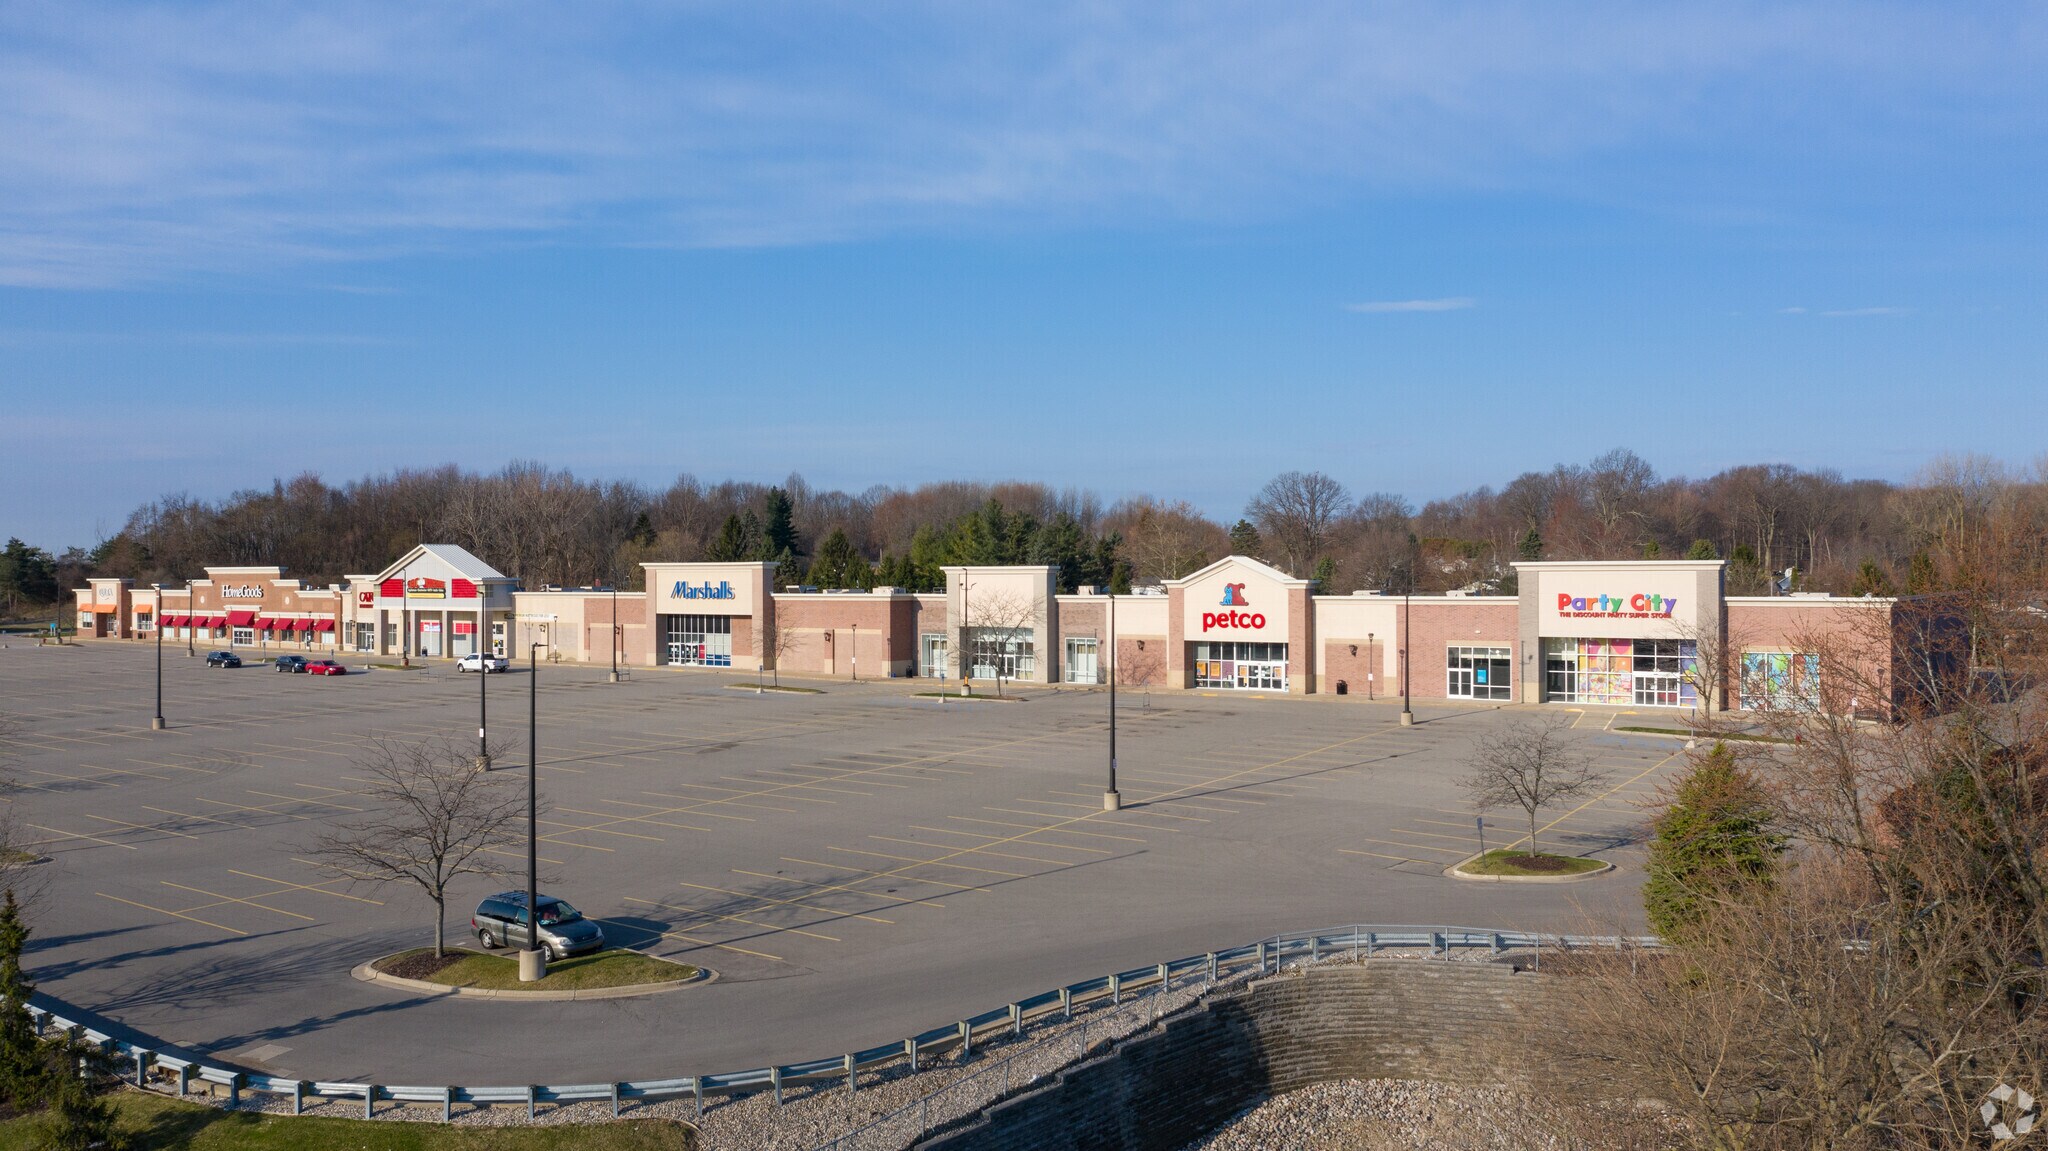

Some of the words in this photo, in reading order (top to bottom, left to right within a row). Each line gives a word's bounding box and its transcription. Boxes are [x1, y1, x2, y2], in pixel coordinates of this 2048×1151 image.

[222, 585, 264, 598] HomeGoods
[671, 581, 736, 600] Marshalls
[1558, 593, 1623, 612] Party
[1630, 593, 1677, 613] City
[1203, 610, 1266, 632] petco
